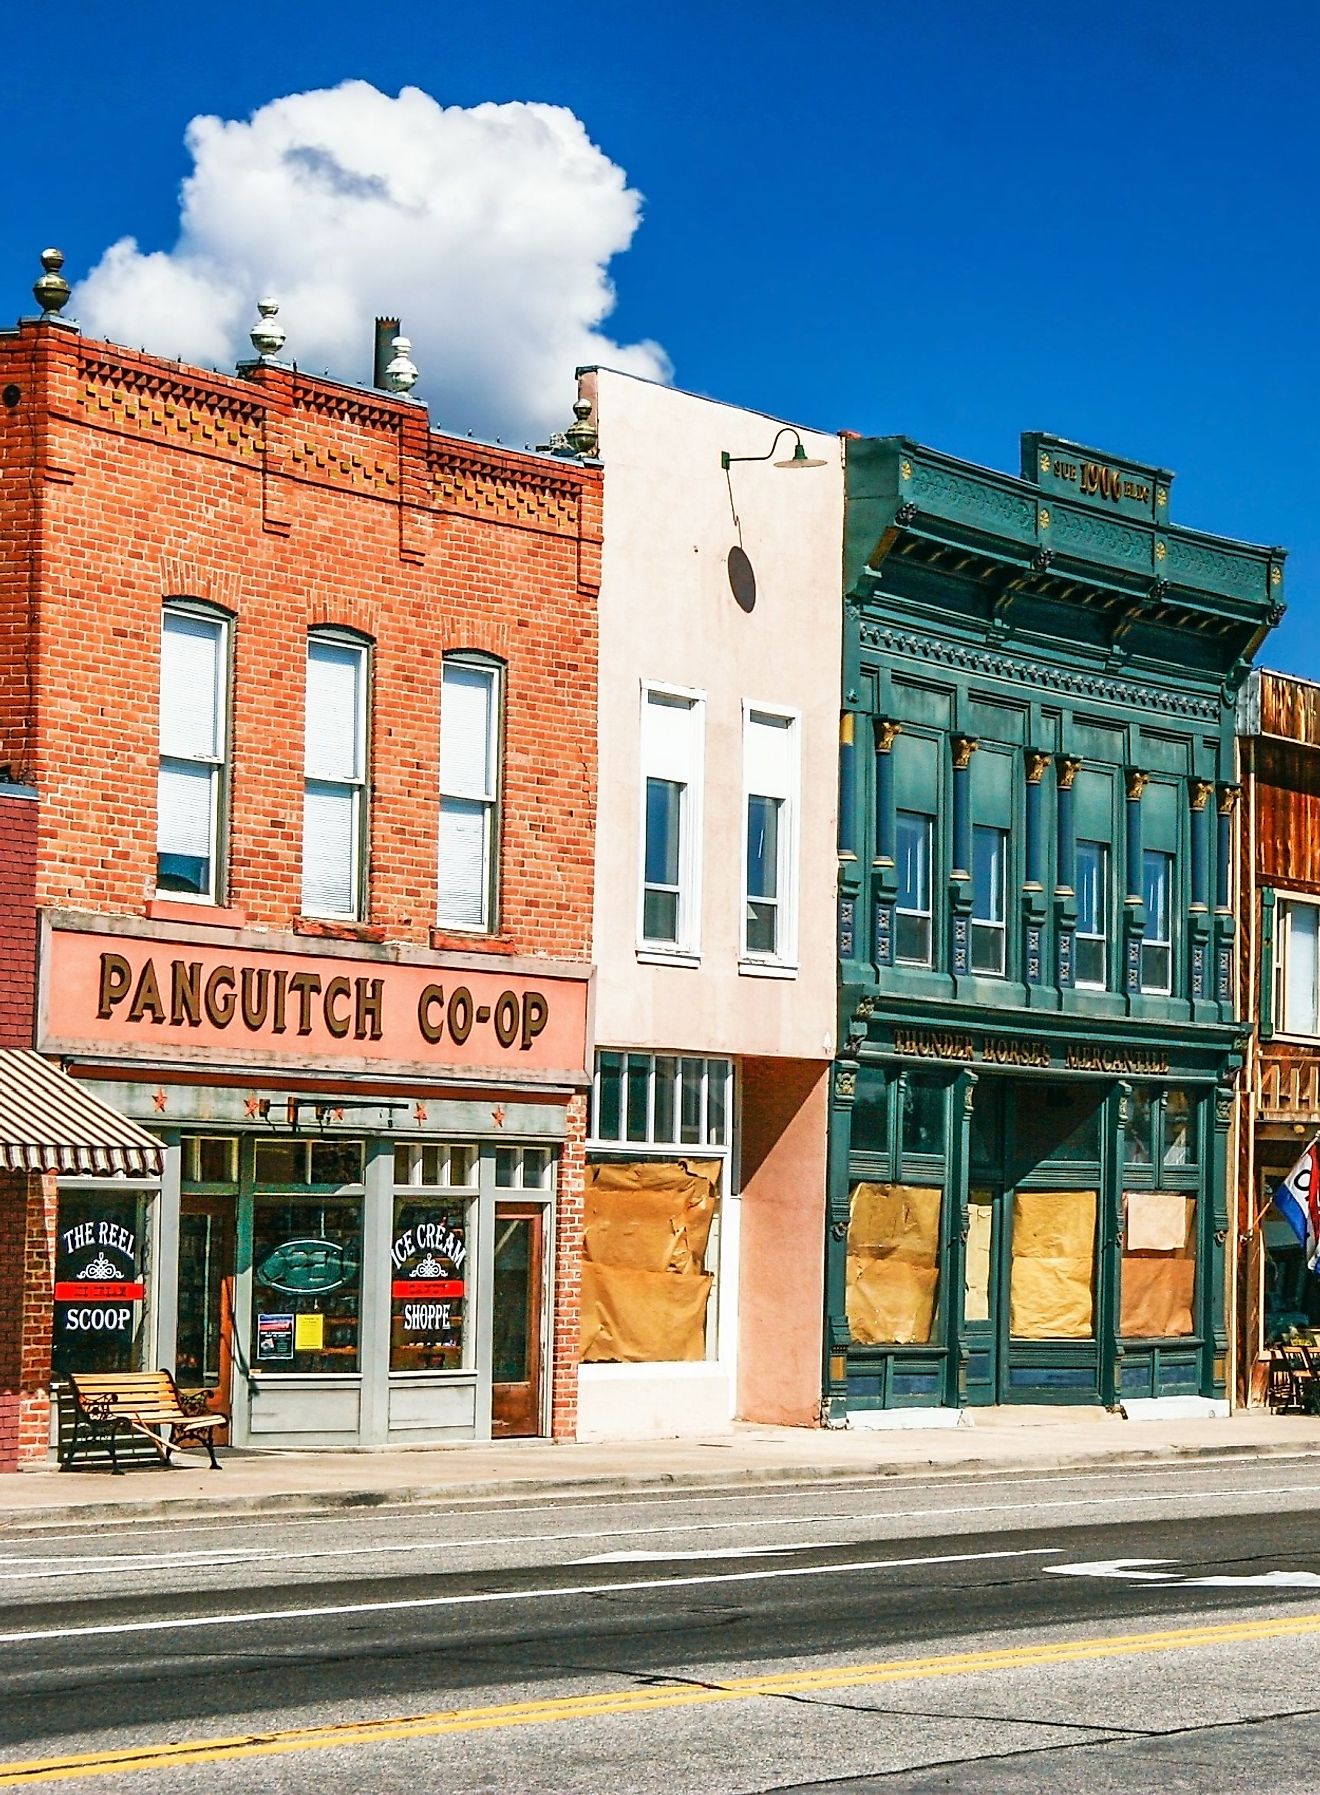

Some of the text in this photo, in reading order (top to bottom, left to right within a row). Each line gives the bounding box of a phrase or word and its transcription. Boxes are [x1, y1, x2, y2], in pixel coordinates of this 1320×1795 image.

[1080, 461, 1121, 503] 1906
[96, 952, 548, 1050] PANGUITCH CO-OP
[893, 1029, 1170, 1075] THUNDER HORSES MERCANTILE
[64, 1221, 135, 1260] THE REEL
[390, 1222, 467, 1270] ICE CREAM
[65, 1308, 131, 1331] SCOOP
[404, 1304, 451, 1330] SHOPPE
